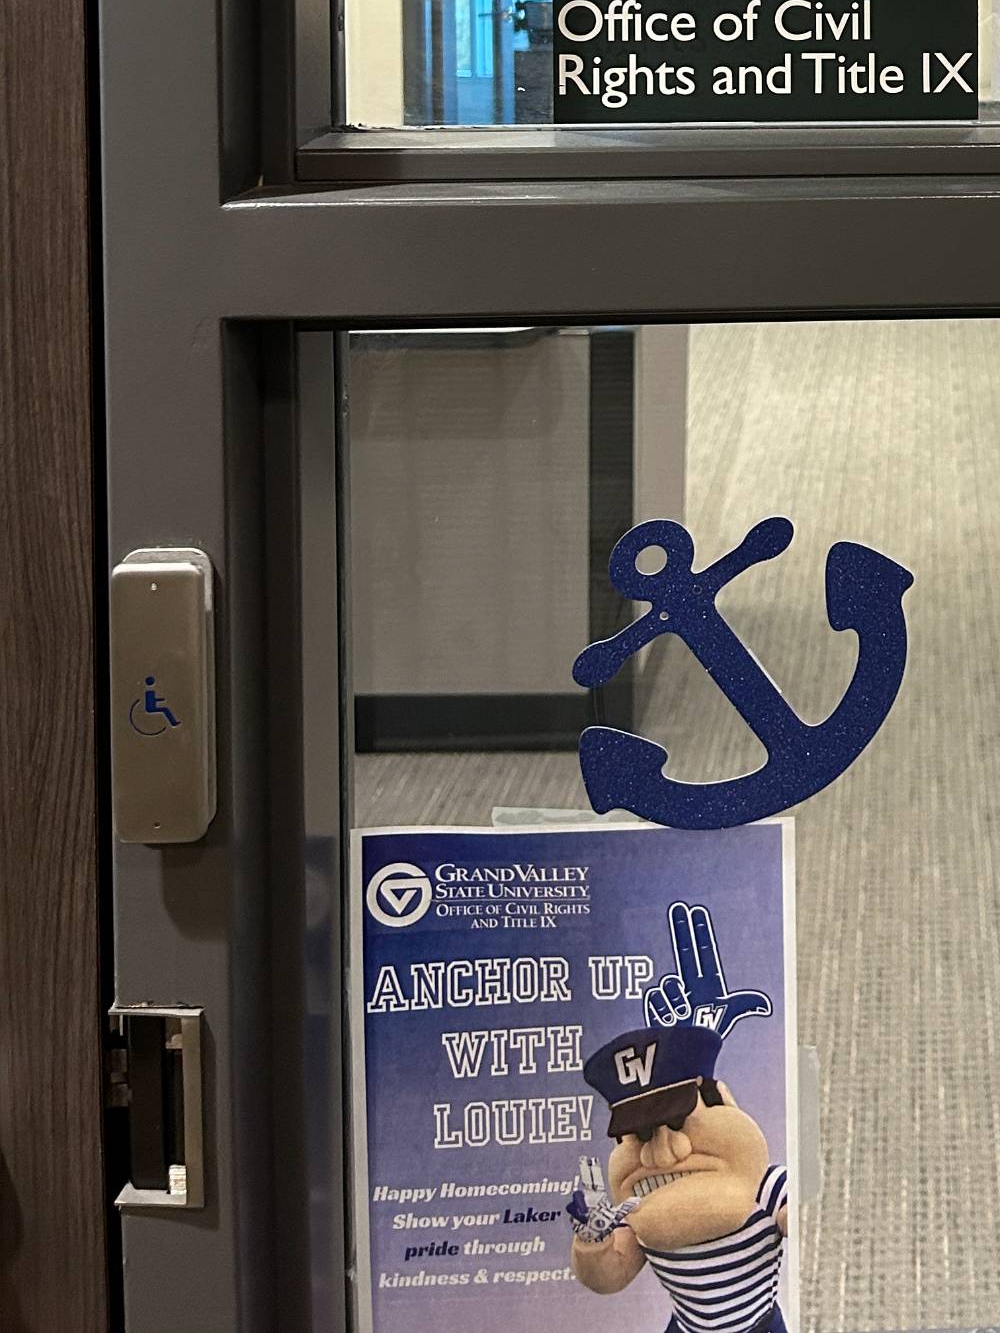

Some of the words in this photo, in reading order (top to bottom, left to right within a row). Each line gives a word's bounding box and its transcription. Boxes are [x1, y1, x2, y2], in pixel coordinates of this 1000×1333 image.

[557, 0, 696, 42] Office
[712, 0, 761, 42] of
[774, 0, 872, 41] Civil
[558, 53, 696, 109] Rights
[712, 53, 792, 95] and
[801, 52, 904, 94] Title
[922, 52, 974, 93] IX
[435, 883, 485, 898] STATE
[436, 903, 483, 916] OFFICE
[486, 904, 502, 915] OF
[505, 902, 540, 915] CIVIL
[544, 902, 590, 915] RIGHTS
[471, 918, 498, 929] AND
[501, 916, 537, 928] TITLE
[541, 916, 557, 928] IX
[367, 956, 572, 1013] ANCHOR
[588, 955, 654, 1001] UP
[442, 1025, 584, 1079] WITH
[613, 1042, 657, 1087] GV
[433, 1094, 594, 1149] LOUIE!
[373, 1184, 436, 1205] Happy
[440, 1175, 580, 1200] Homecoming!
[392, 1213, 449, 1230] Show
[452, 1213, 500, 1230] your
[503, 1208, 561, 1225] Laker
[404, 1241, 460, 1261] pride
[463, 1236, 545, 1257] through
[379, 1269, 471, 1288] kindness
[474, 1269, 489, 1284] &
[492, 1267, 577, 1287] respect.
